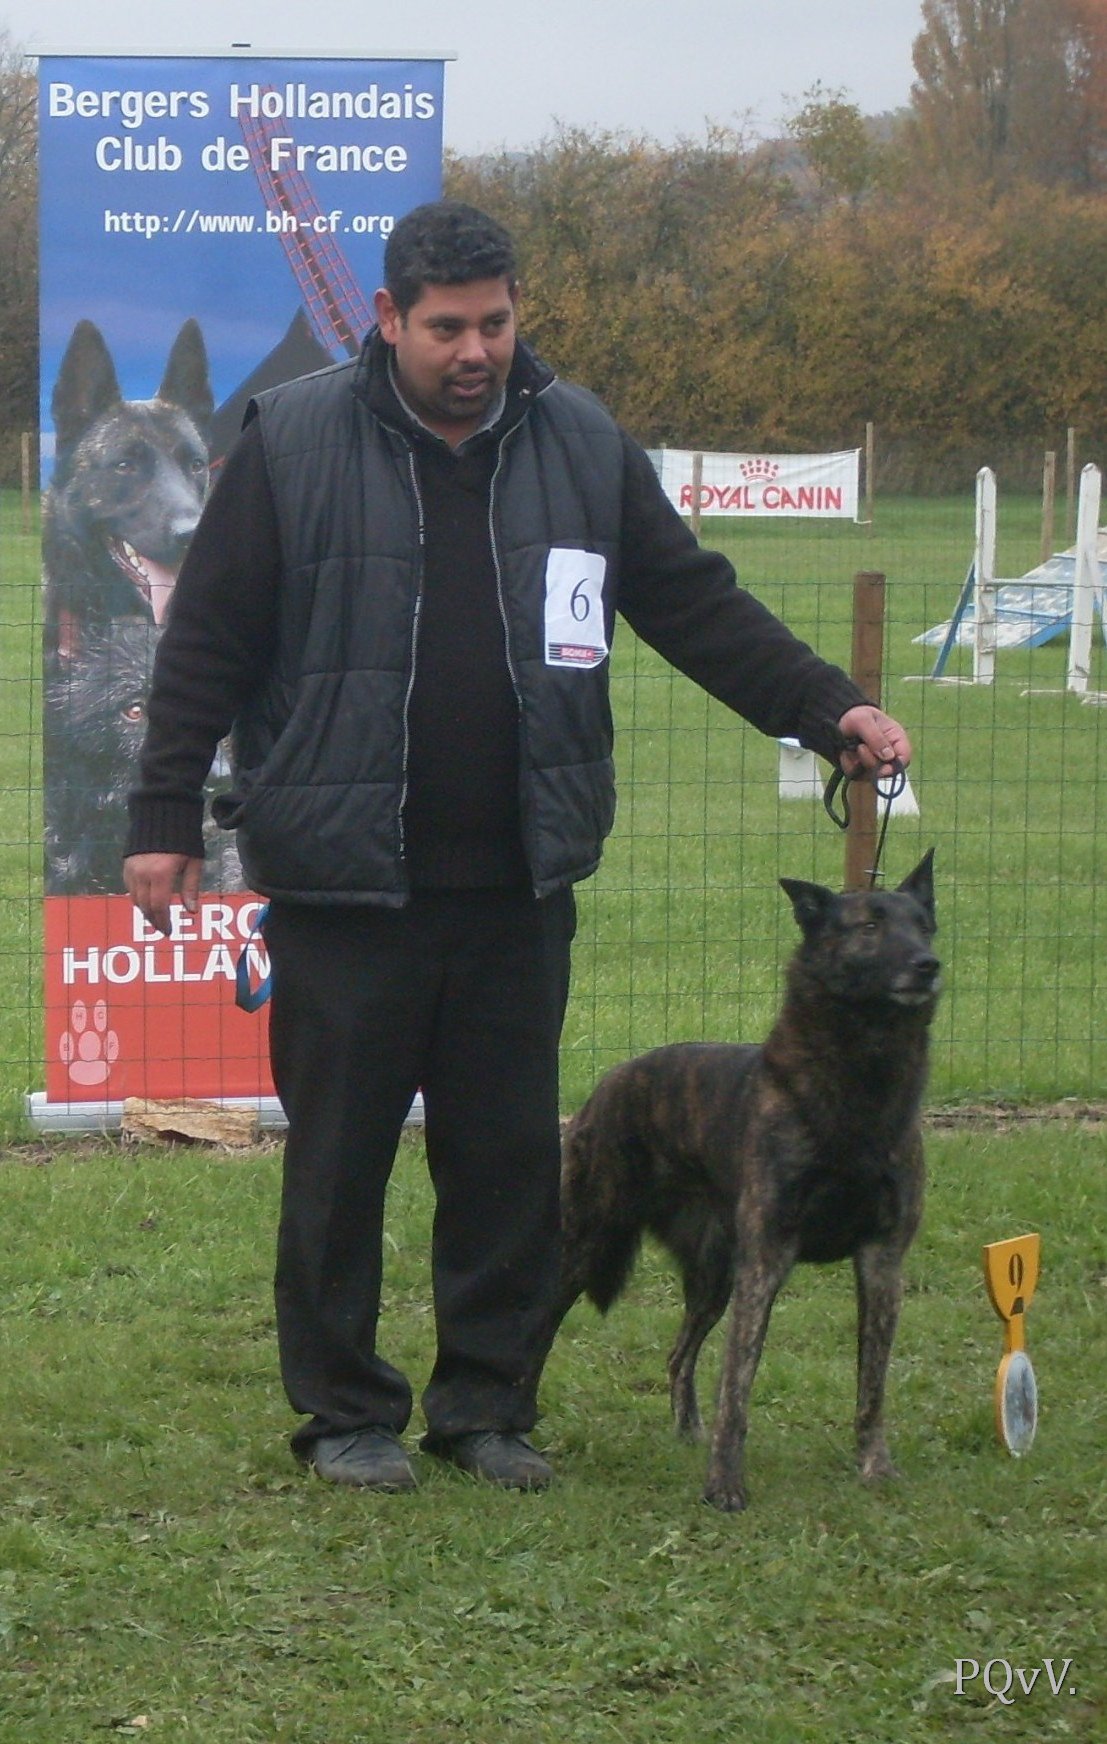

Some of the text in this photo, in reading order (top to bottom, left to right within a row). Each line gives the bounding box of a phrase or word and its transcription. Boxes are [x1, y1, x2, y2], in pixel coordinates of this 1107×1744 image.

[49, 83, 435, 129] Bergers Hollandais
[95, 136, 407, 172] Club de France
[104, 209, 394, 240] http://www.bh-cf.org
[680, 484, 842, 510] ROYAL CANIN
[570, 577, 590, 622] 6
[62, 943, 271, 984] HOLLAN
